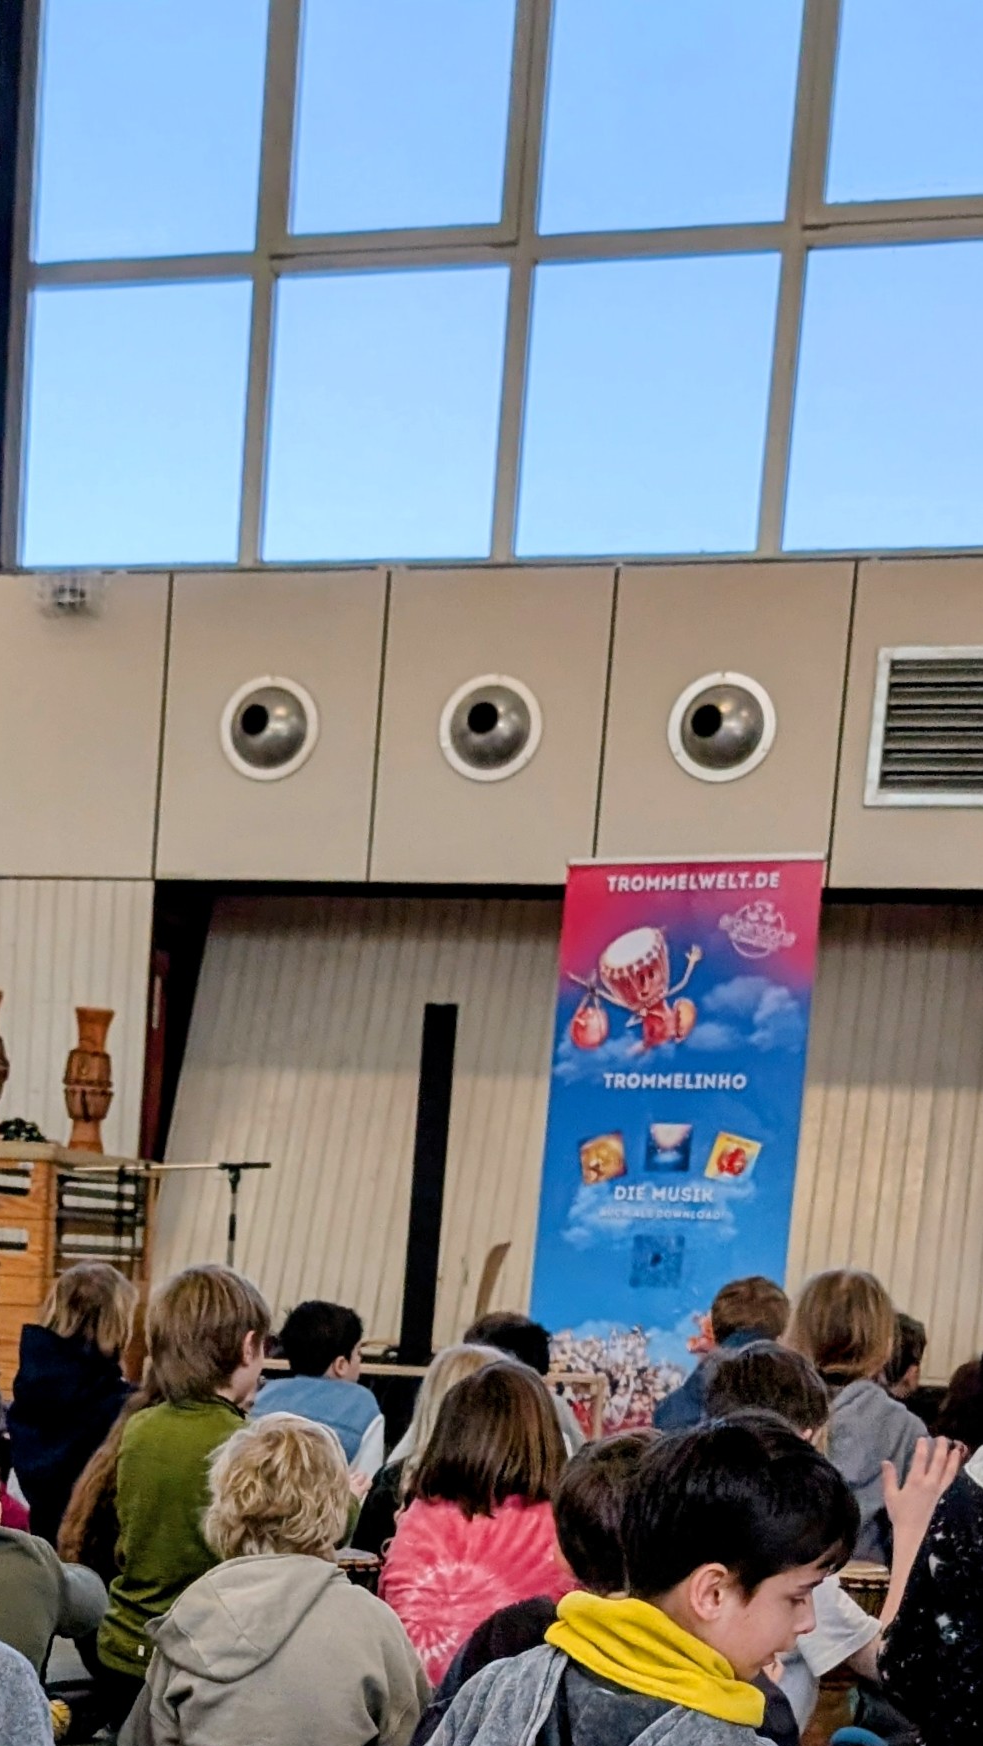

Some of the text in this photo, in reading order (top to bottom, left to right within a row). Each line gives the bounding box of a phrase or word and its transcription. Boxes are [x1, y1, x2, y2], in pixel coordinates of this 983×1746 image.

[606, 872, 781, 893] TROMMELWELT.DE
[603, 1072, 748, 1091] TROMMELINHO
[613, 1184, 715, 1203] DIE MUSIK
